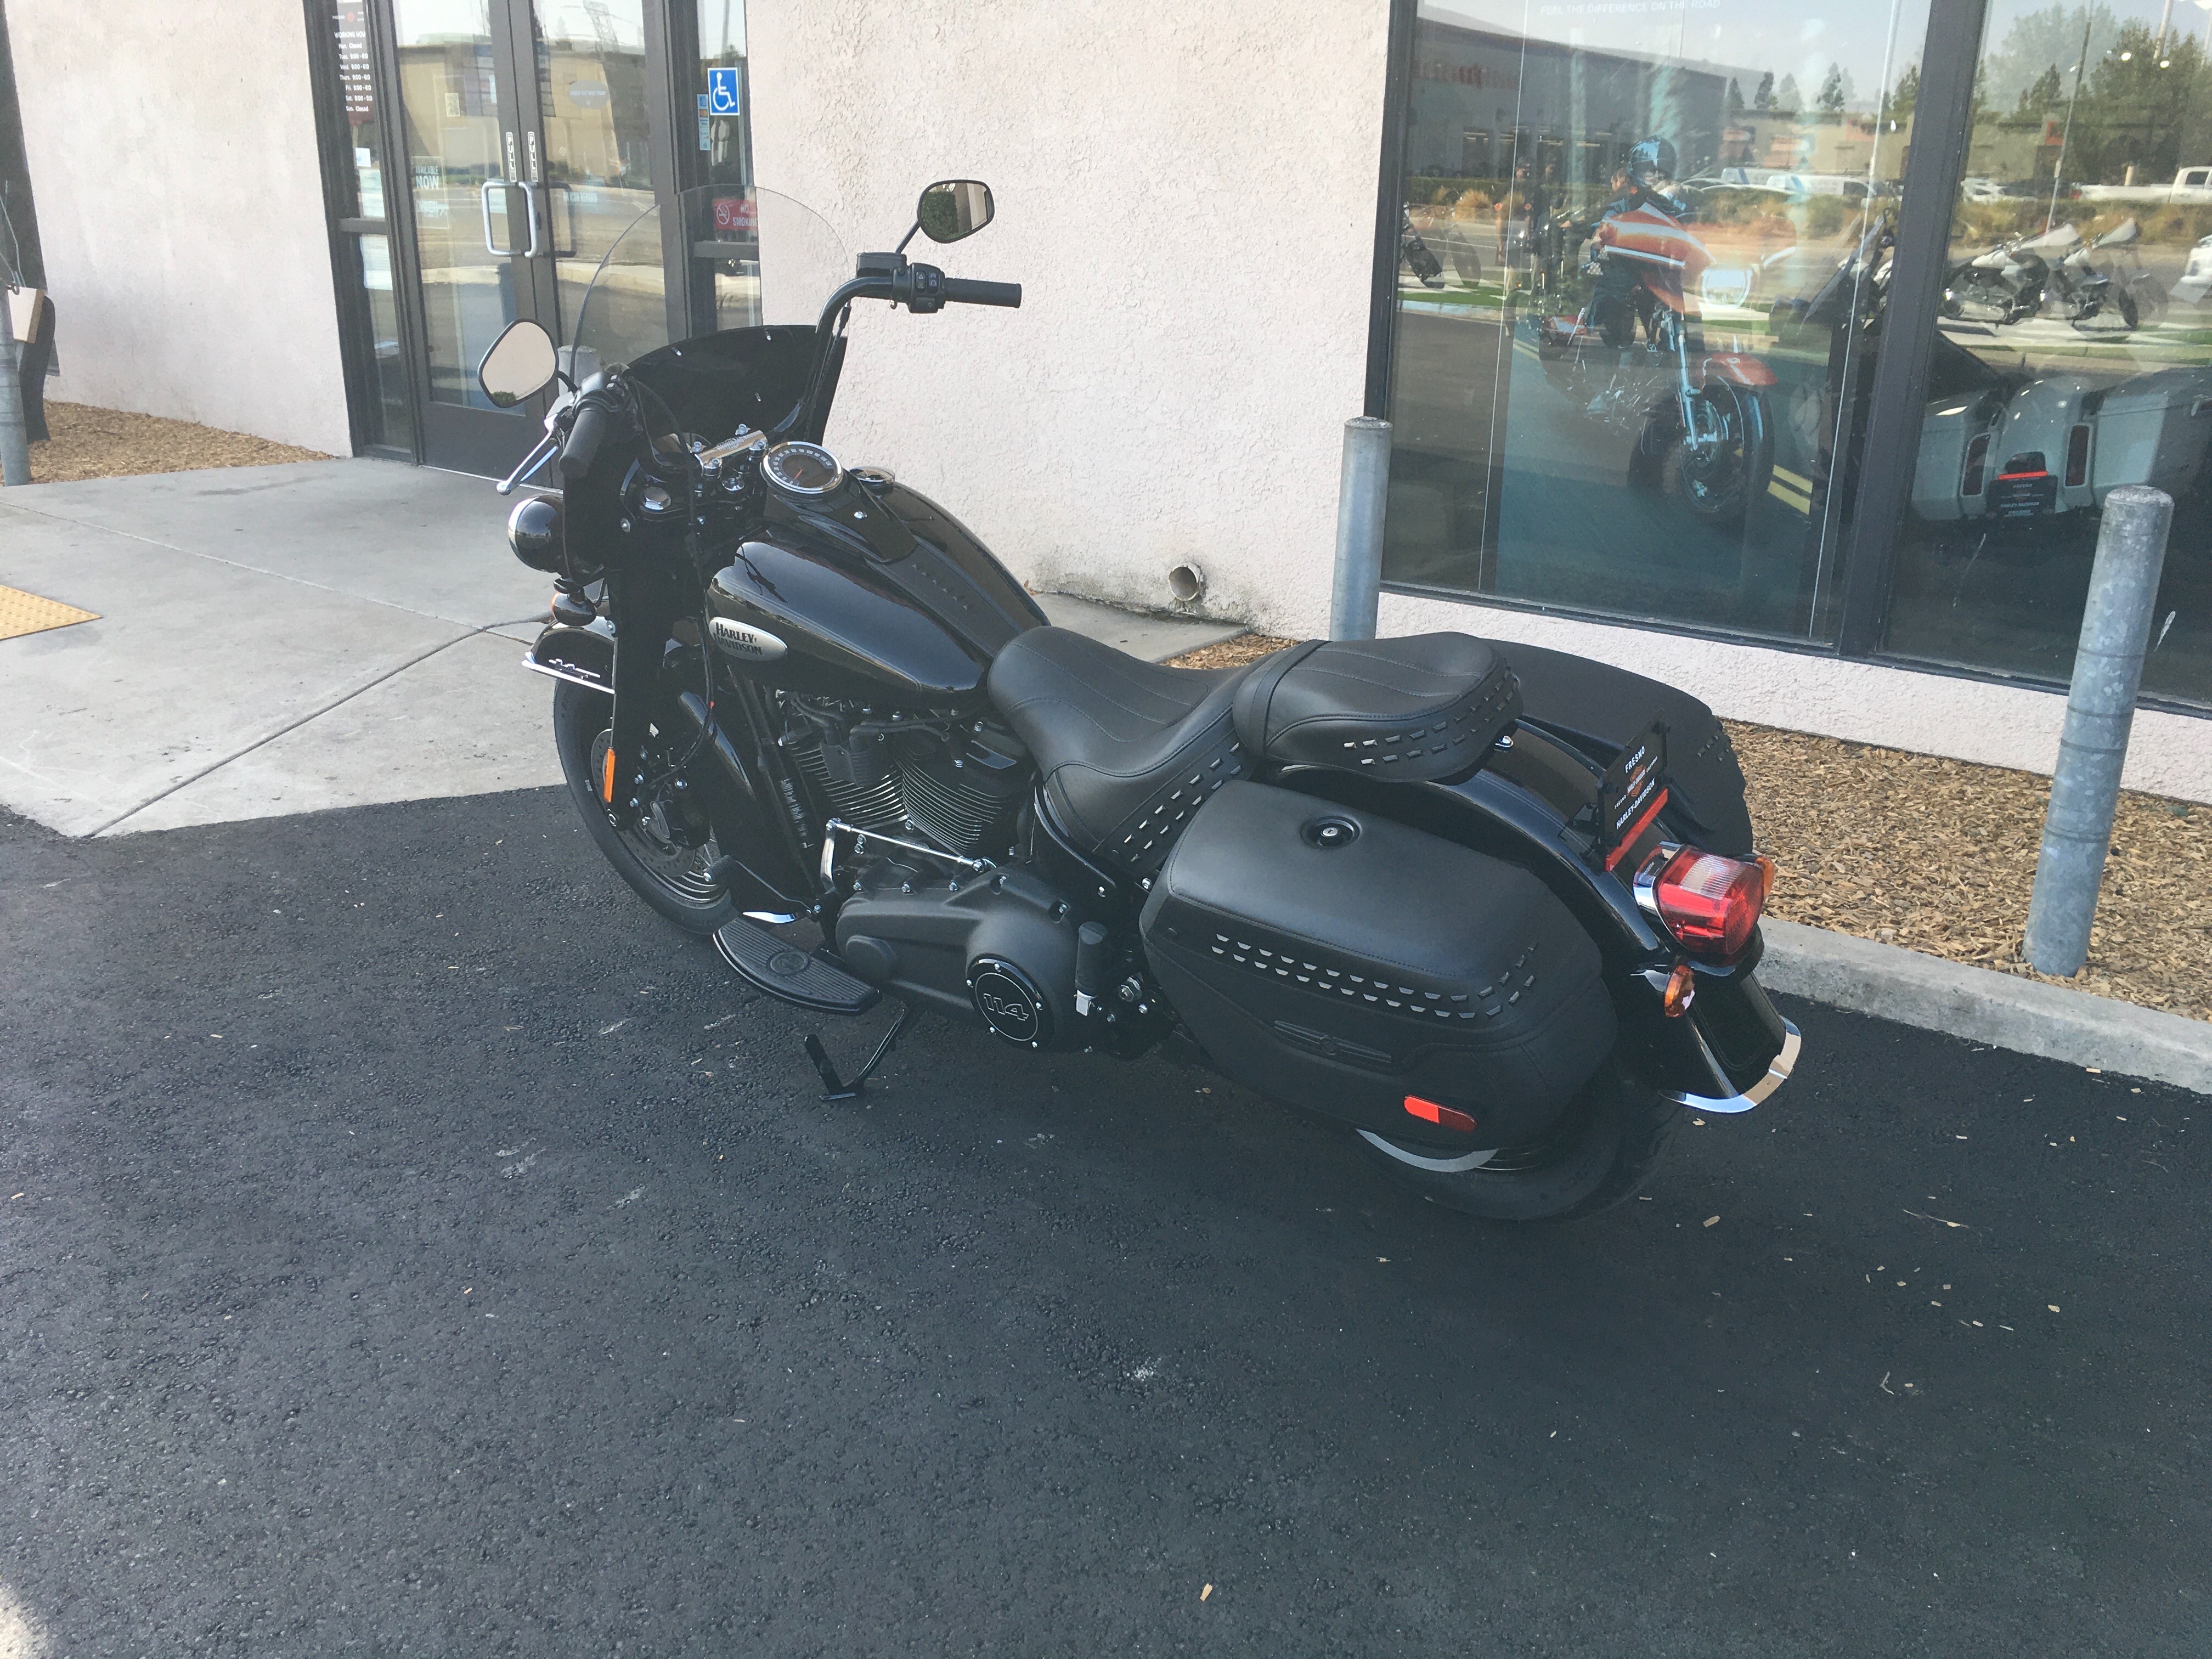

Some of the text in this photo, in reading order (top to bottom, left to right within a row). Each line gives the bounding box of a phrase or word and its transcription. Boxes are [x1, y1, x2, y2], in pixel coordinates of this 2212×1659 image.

[1541, 5, 1564, 15] FEEL
[1568, 4, 1583, 13] THE
[1588, 2, 1646, 13] DIFFERENCE
[1652, 1, 1665, 11] ON
[1670, 0, 1686, 9] THE
[415, 166, 438, 174] AVAILABLE
[416, 176, 439, 190] NOW
[740, 204, 749, 214] NO
[713, 632, 763, 655] DAVIDSON
[1625, 746, 1645, 774] FRESNO
[1616, 777, 1655, 830] HARLEY-DAVIDSON
[983, 992, 1029, 1021] 114
